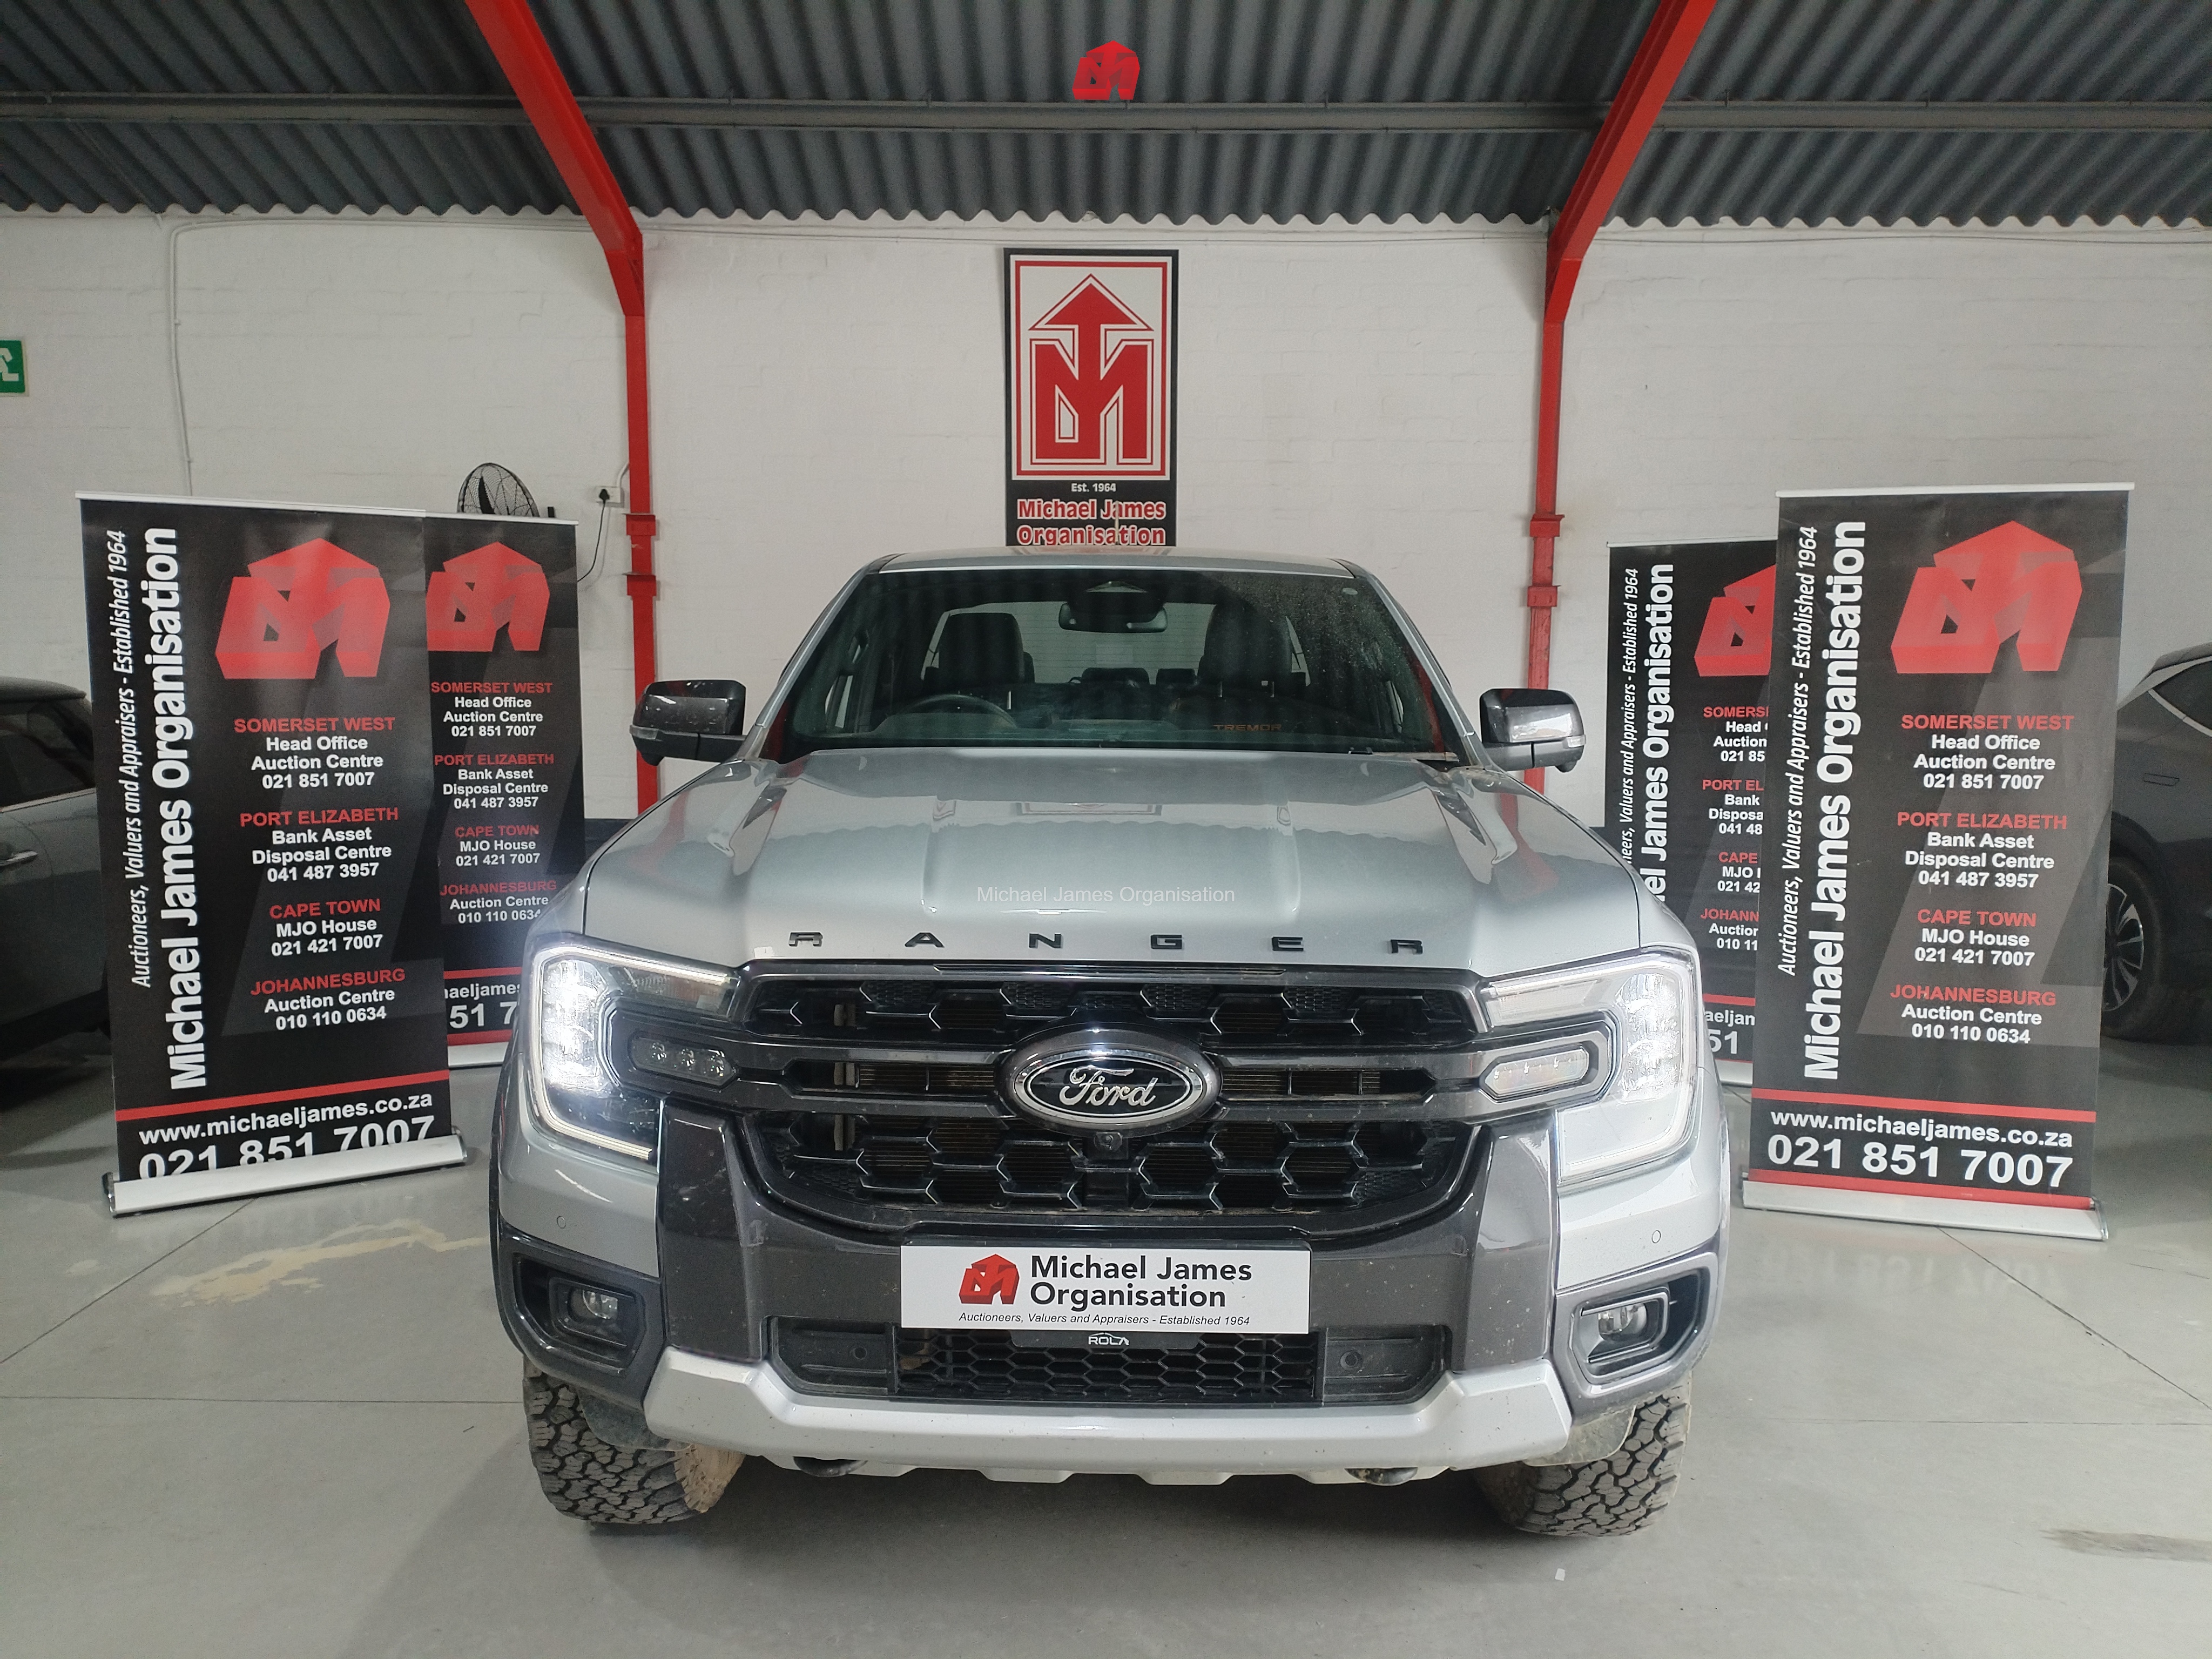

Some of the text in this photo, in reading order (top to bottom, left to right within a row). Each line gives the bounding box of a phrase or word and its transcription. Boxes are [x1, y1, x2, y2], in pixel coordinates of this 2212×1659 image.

[1071, 483, 1116, 493] Est. 1964
[1017, 498, 1166, 520] Michael James
[1017, 524, 1166, 545] Organisation
[1624, 569, 1638, 599] 1964
[1622, 602, 1637, 673] Established
[1643, 563, 1674, 758] Organisation
[431, 681, 552, 693] SOMERSET WEST
[455, 696, 532, 708] Head Office
[234, 717, 395, 733] SOMERSET WEST
[443, 711, 543, 723] Auction Centre
[1621, 683, 1638, 750] Appraisers
[1901, 714, 2074, 730] SOMERSET WEST
[451, 725, 536, 737] 021 851 7007
[1725, 721, 1762, 733] Head
[266, 736, 368, 751] Head Office
[1713, 736, 1768, 747] Auction
[1931, 734, 2041, 750] Head Office
[106, 530, 151, 988] Auctioneers, Valuers and Appraisers Established 1964
[434, 753, 555, 766] PORT ELIZABETH
[1777, 527, 1817, 976] Auctioneers, Valuers and Appraisers Established 1964
[251, 754, 383, 771] Auction Centre
[1620, 750, 1634, 775] and
[1913, 753, 2056, 770] Auction Centre
[262, 772, 375, 789] 021 851 7007
[458, 768, 534, 780] Bank Asset
[1923, 773, 2045, 790] 021 851 7007
[443, 783, 548, 797] Disposal Centre
[1702, 779, 1742, 791] PORT
[454, 796, 538, 809] 041 487 3957
[1619, 778, 1634, 822] Valuers
[1724, 793, 1760, 806] Bank
[1804, 522, 1866, 1080] Michael James Organisation
[140, 528, 206, 1090] Michael James Organisation
[240, 807, 399, 827] PORT ELIZABETH
[1641, 766, 1669, 861] James
[1897, 812, 2067, 830] PORT ELIZABETH
[272, 827, 372, 845] Bank Asset
[455, 825, 539, 838] CAPE TOWN
[1927, 832, 2034, 849] Bank Asset
[460, 840, 536, 852] MJO House
[252, 845, 392, 866] Disposal Centre
[456, 853, 541, 867] 021 421 7007
[1718, 852, 1758, 864] CAPE
[1905, 851, 2055, 869] Disposal Centre
[267, 862, 380, 882] 041 487 3957
[1722, 866, 1754, 878] MJO
[1918, 870, 2039, 888] 041 487 3957
[440, 880, 556, 896] JOHANNESBURG
[269, 898, 381, 919] CAPE TOWN
[449, 895, 549, 910] Auction Centre
[458, 912, 481, 924] 010
[485, 911, 508, 922] 110
[1917, 909, 2036, 927] CAPE TOWN
[276, 919, 377, 938] MJO House
[1921, 928, 2030, 947] MJO House
[271, 934, 383, 956] 021 421 7007
[788, 932, 1423, 955] RANGER
[1914, 947, 2035, 966] 021 421 7007
[251, 968, 405, 996] JOHANNESBURG
[264, 989, 395, 1013] Auction Centre
[1890, 984, 2056, 1006] JOHANNESBURG
[275, 1006, 387, 1030] 010 110 0634
[1901, 1003, 2042, 1025] Auction Centre
[1912, 1023, 2031, 1044] 010 110 0634
[1059, 1065, 1158, 1107] Ford
[138, 1094, 433, 1145] www.michaeljames.co.za
[1770, 1109, 2073, 1148] www.michaeljames.co.za
[139, 1115, 435, 1180] 021 851 7007
[1768, 1134, 2073, 1188] 021 851 7007
[1031, 1255, 1252, 1281] Michael James
[1030, 1282, 1225, 1312] Organisation
[959, 1312, 1250, 1325] Auctioneers, Valuers and Appraisers Established 1964
[1088, 1336, 1129, 1345] ROLA
